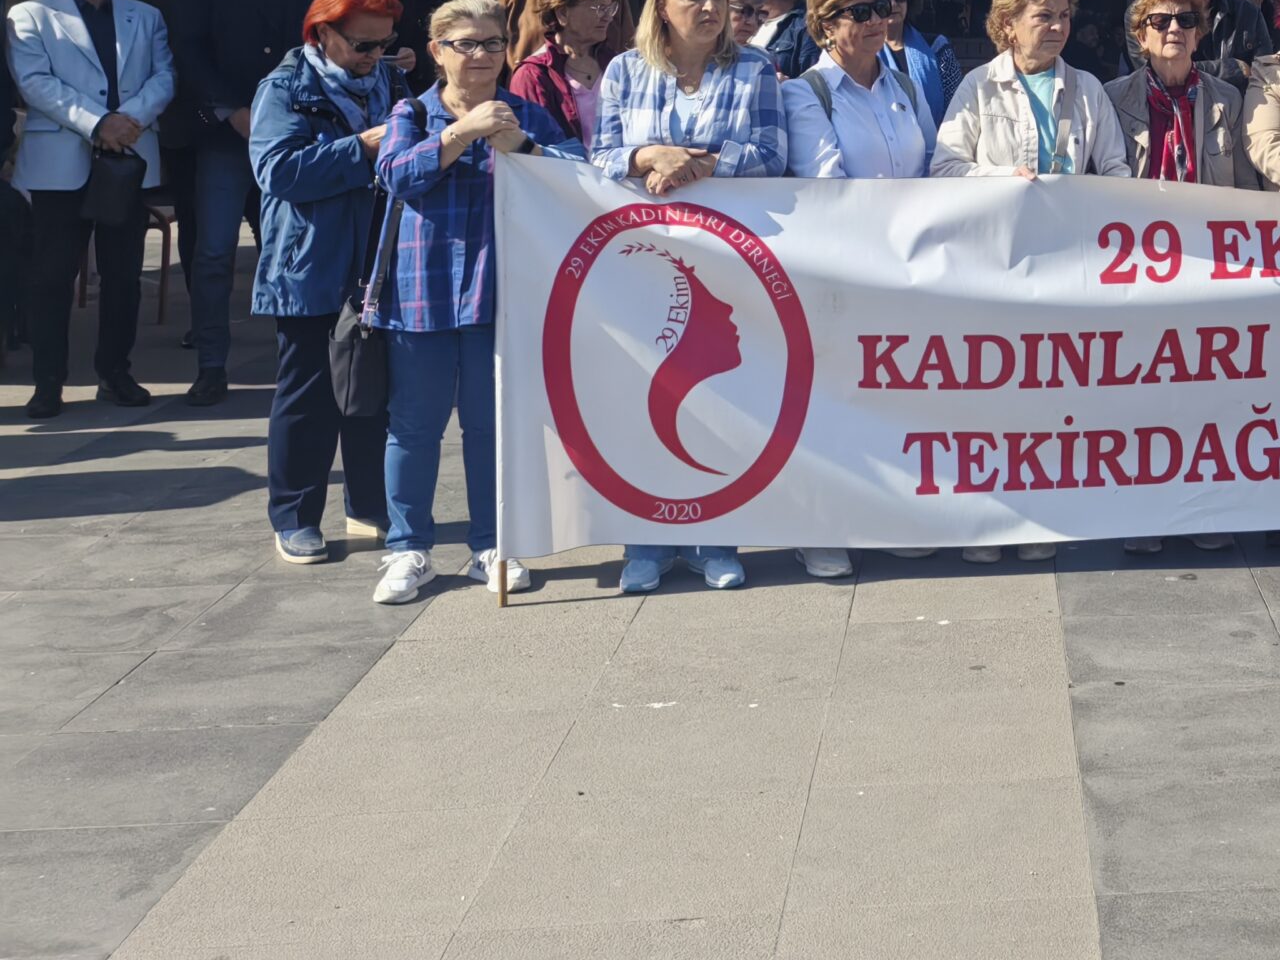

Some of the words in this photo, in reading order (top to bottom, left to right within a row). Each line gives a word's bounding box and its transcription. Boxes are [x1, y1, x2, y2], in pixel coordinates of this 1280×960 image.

[565, 257, 585, 279] 29
[580, 220, 618, 255] EKİM
[616, 208, 727, 233] KADINLARI
[729, 229, 792, 300] DERNEĞİ
[1097, 220, 1182, 284] 29
[667, 276, 690, 325] Ekim
[656, 327, 679, 353] 29
[857, 324, 1270, 390] KADINLARI
[652, 502, 701, 521] 2020
